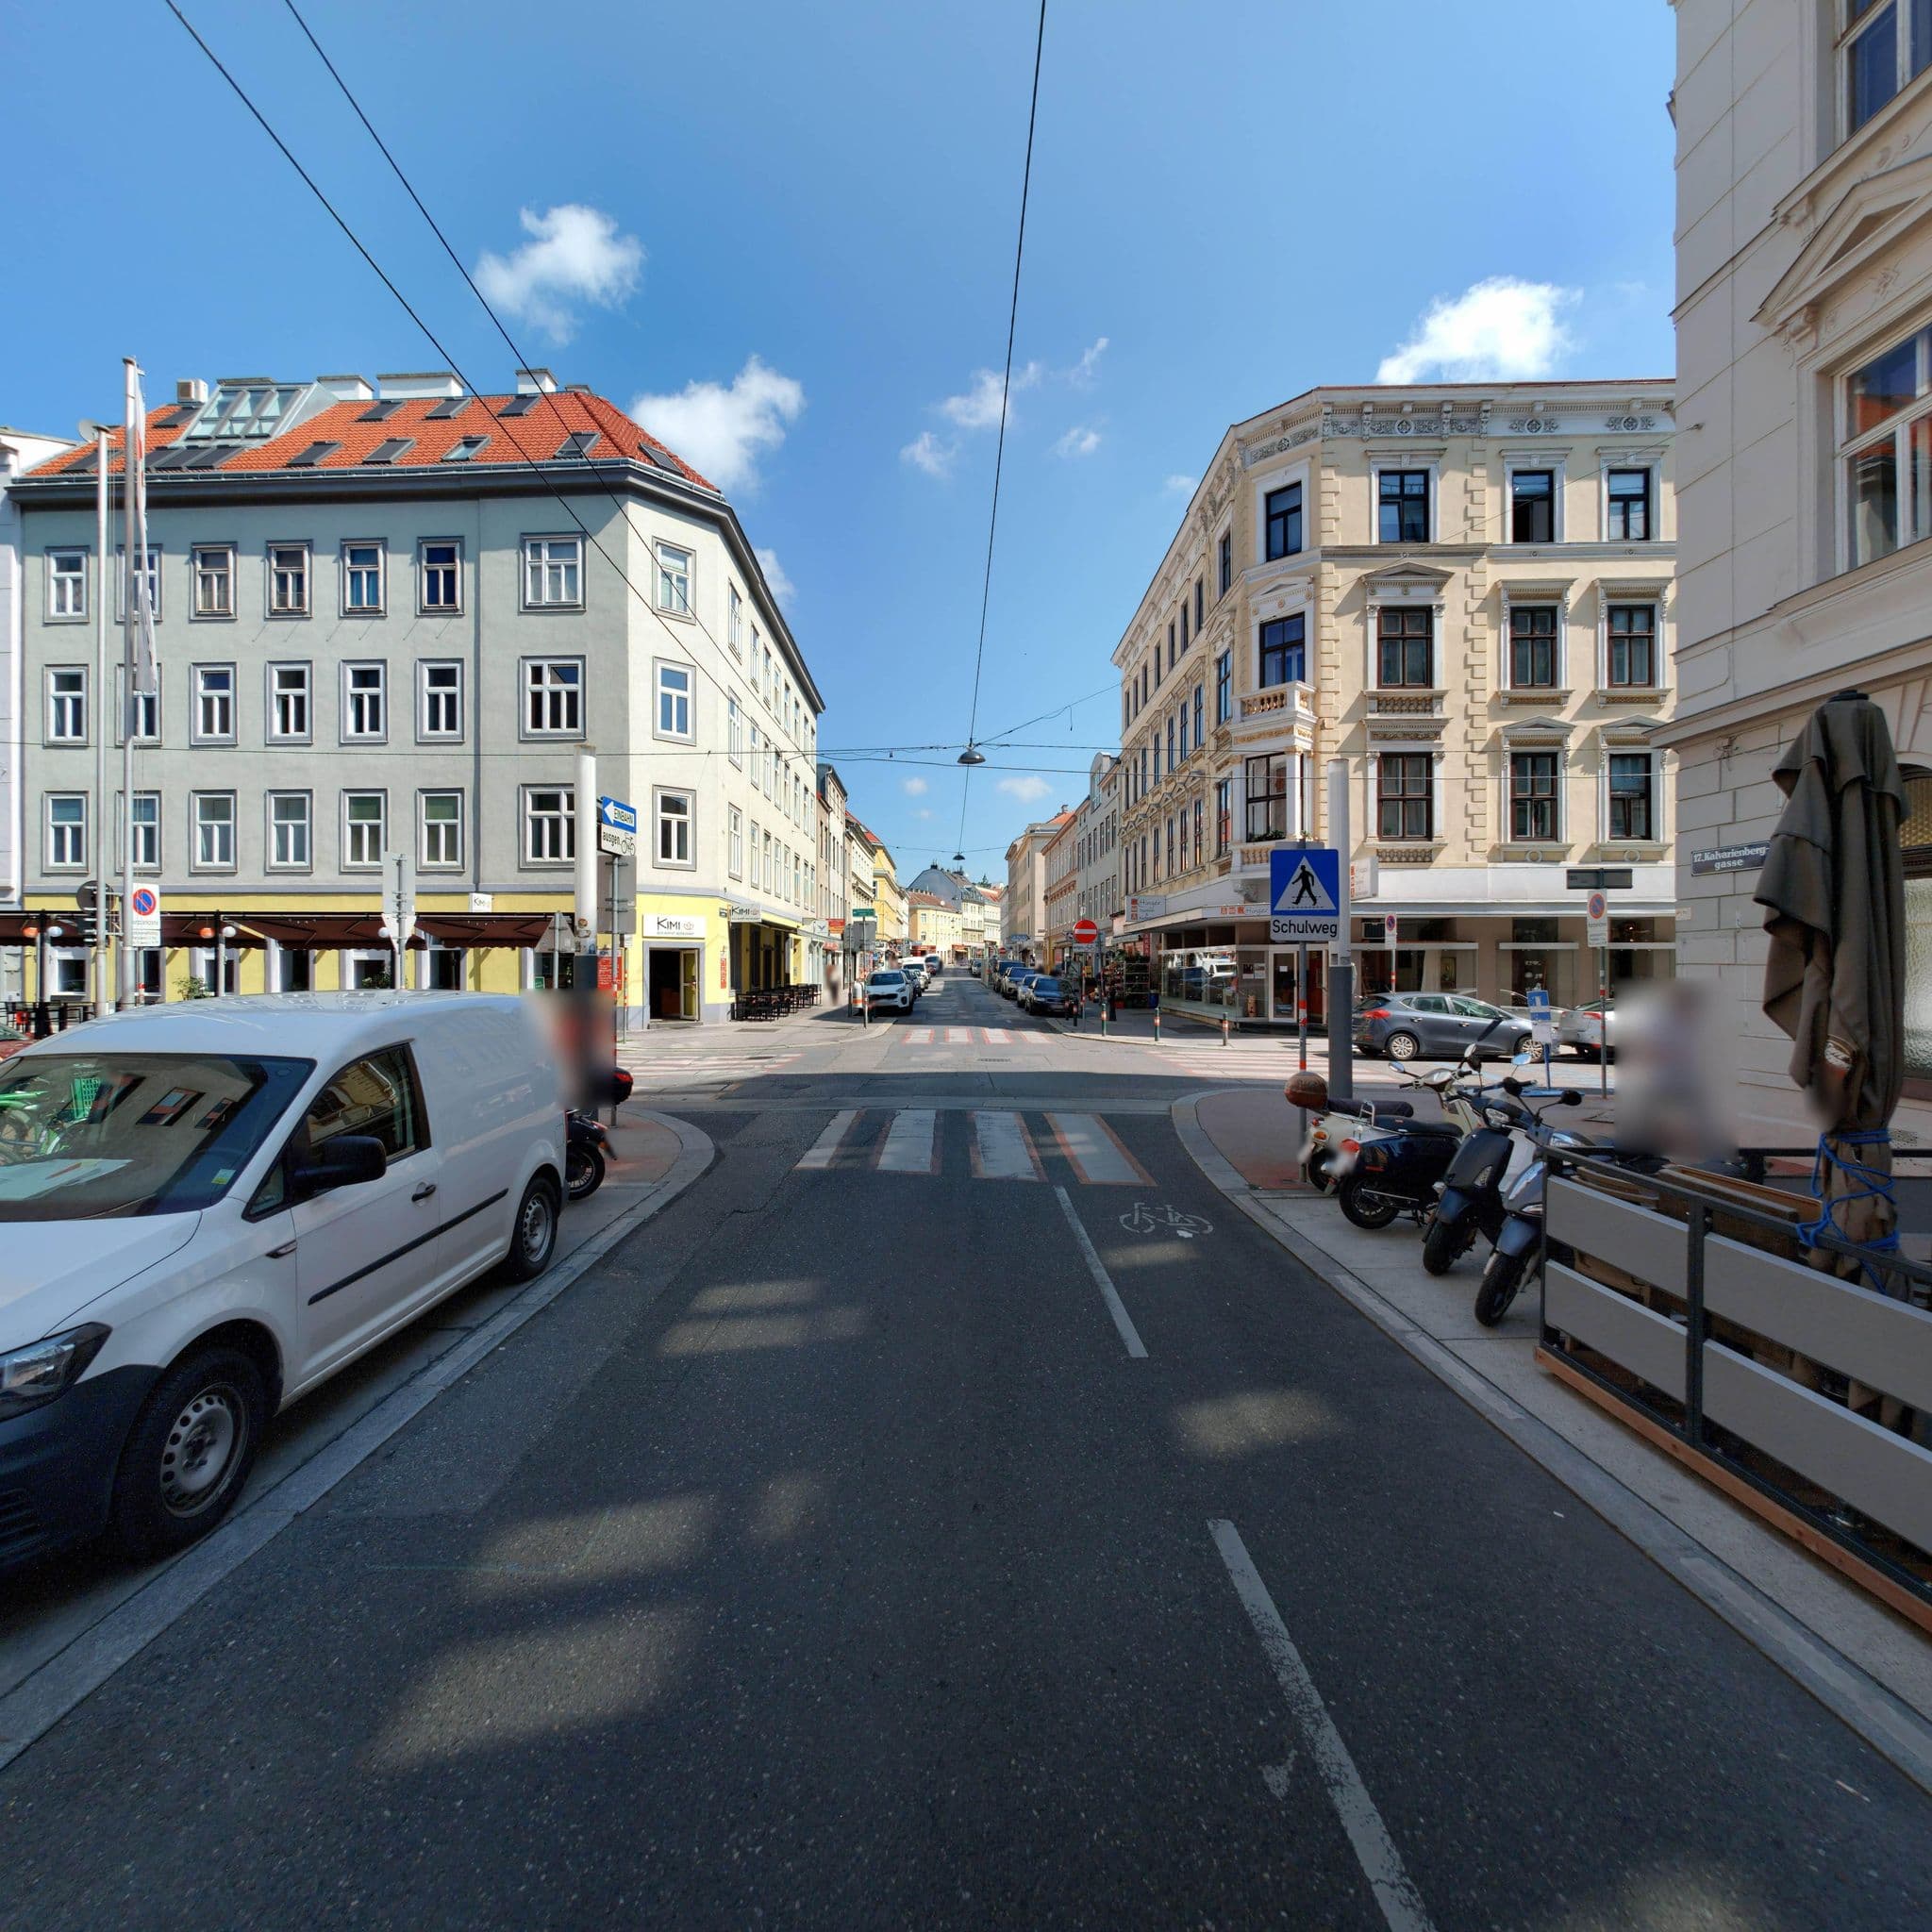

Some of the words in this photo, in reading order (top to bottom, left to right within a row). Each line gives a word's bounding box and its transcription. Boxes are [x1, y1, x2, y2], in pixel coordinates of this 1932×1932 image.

[613, 808, 633, 824] EINBAHN
[1714, 858, 1743, 871] gasse
[731, 906, 750, 915] KIMI
[657, 916, 680, 930] KIMI
[1273, 919, 1338, 938] Schulweg
